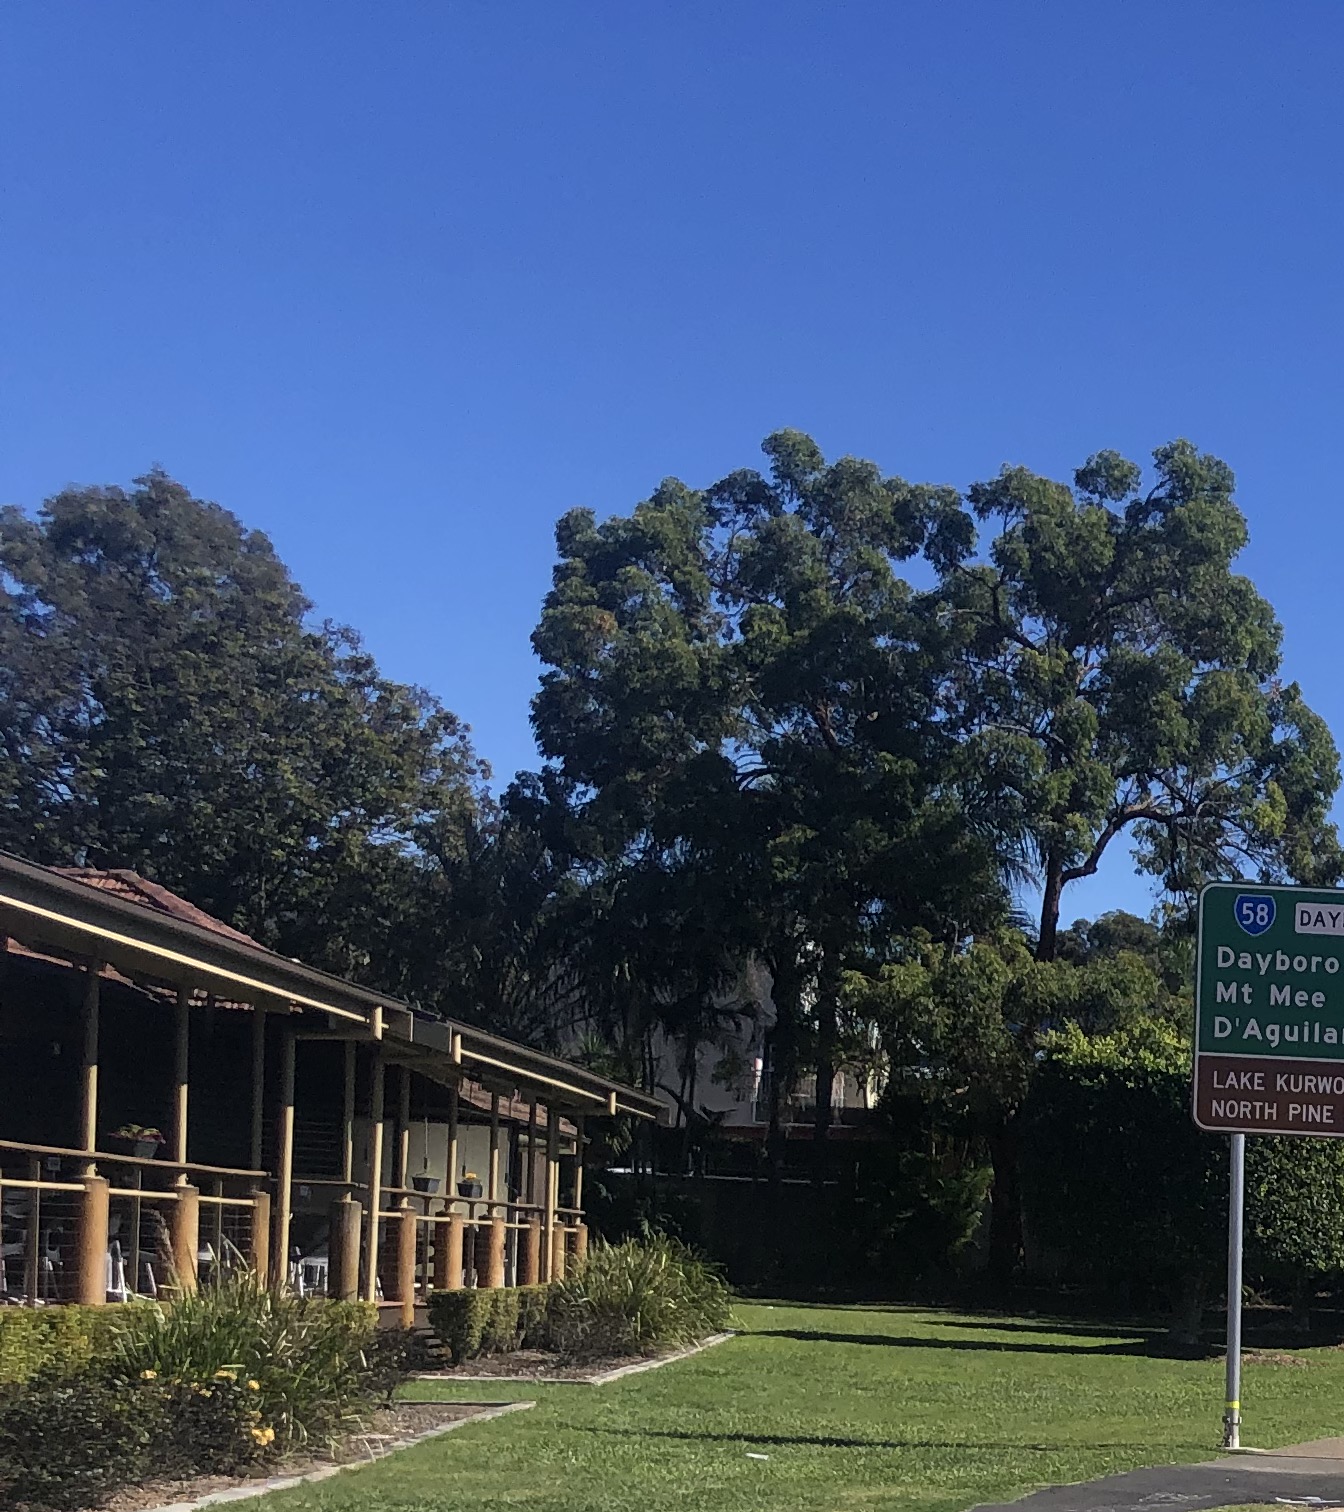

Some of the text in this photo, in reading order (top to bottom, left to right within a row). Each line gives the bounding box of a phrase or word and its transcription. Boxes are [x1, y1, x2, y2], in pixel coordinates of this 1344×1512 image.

[1241, 902, 1269, 926] 58
[1216, 945, 1340, 976] Dayboro
[1215, 981, 1253, 1005] Mt
[1269, 985, 1326, 1008] Mee
[1212, 1070, 1265, 1091] LAKE
[1211, 1100, 1277, 1121] NORTH
[1288, 1103, 1334, 1124] PINE
